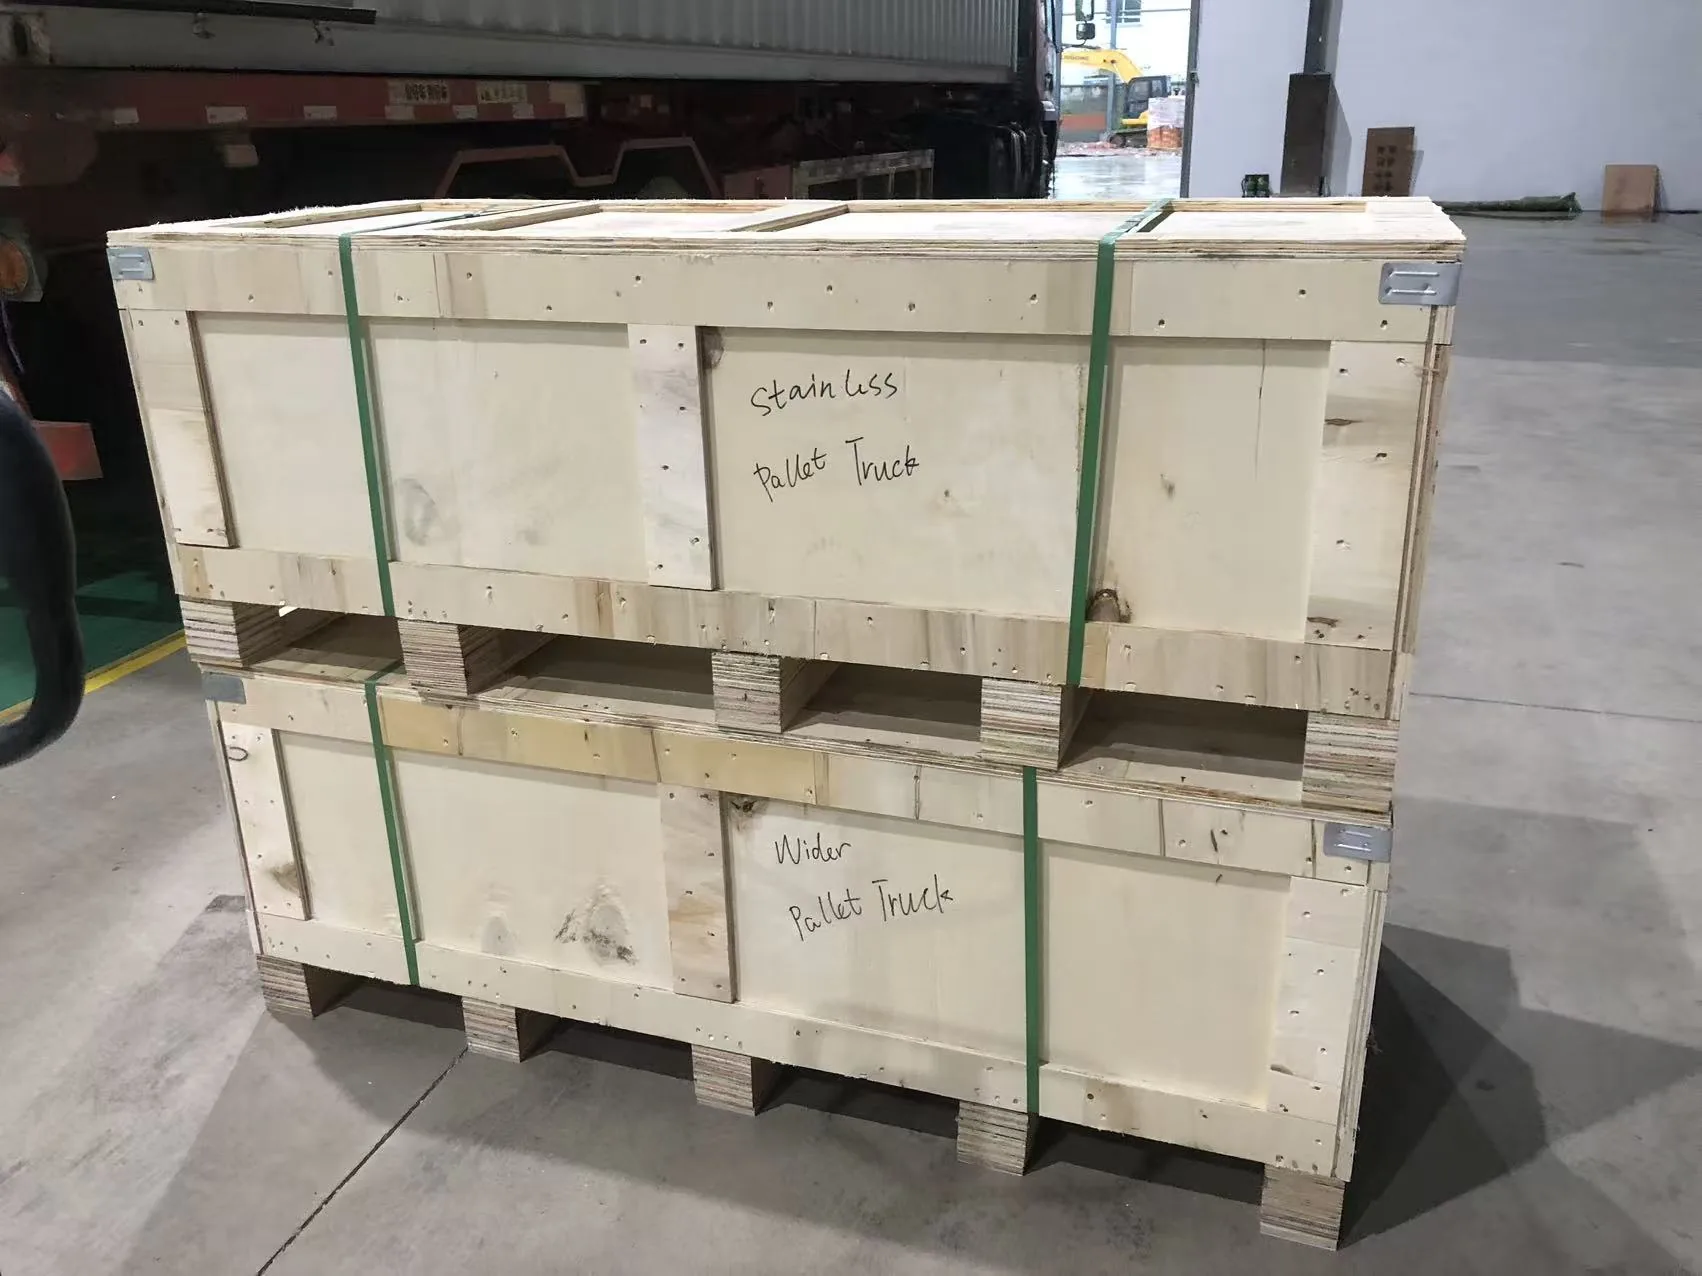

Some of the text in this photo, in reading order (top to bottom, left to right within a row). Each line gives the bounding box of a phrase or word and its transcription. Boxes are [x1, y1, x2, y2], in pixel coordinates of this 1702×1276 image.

[844, 436, 920, 487] Truck
[774, 831, 852, 865] Wider
[788, 873, 954, 942] Pallet Truck
